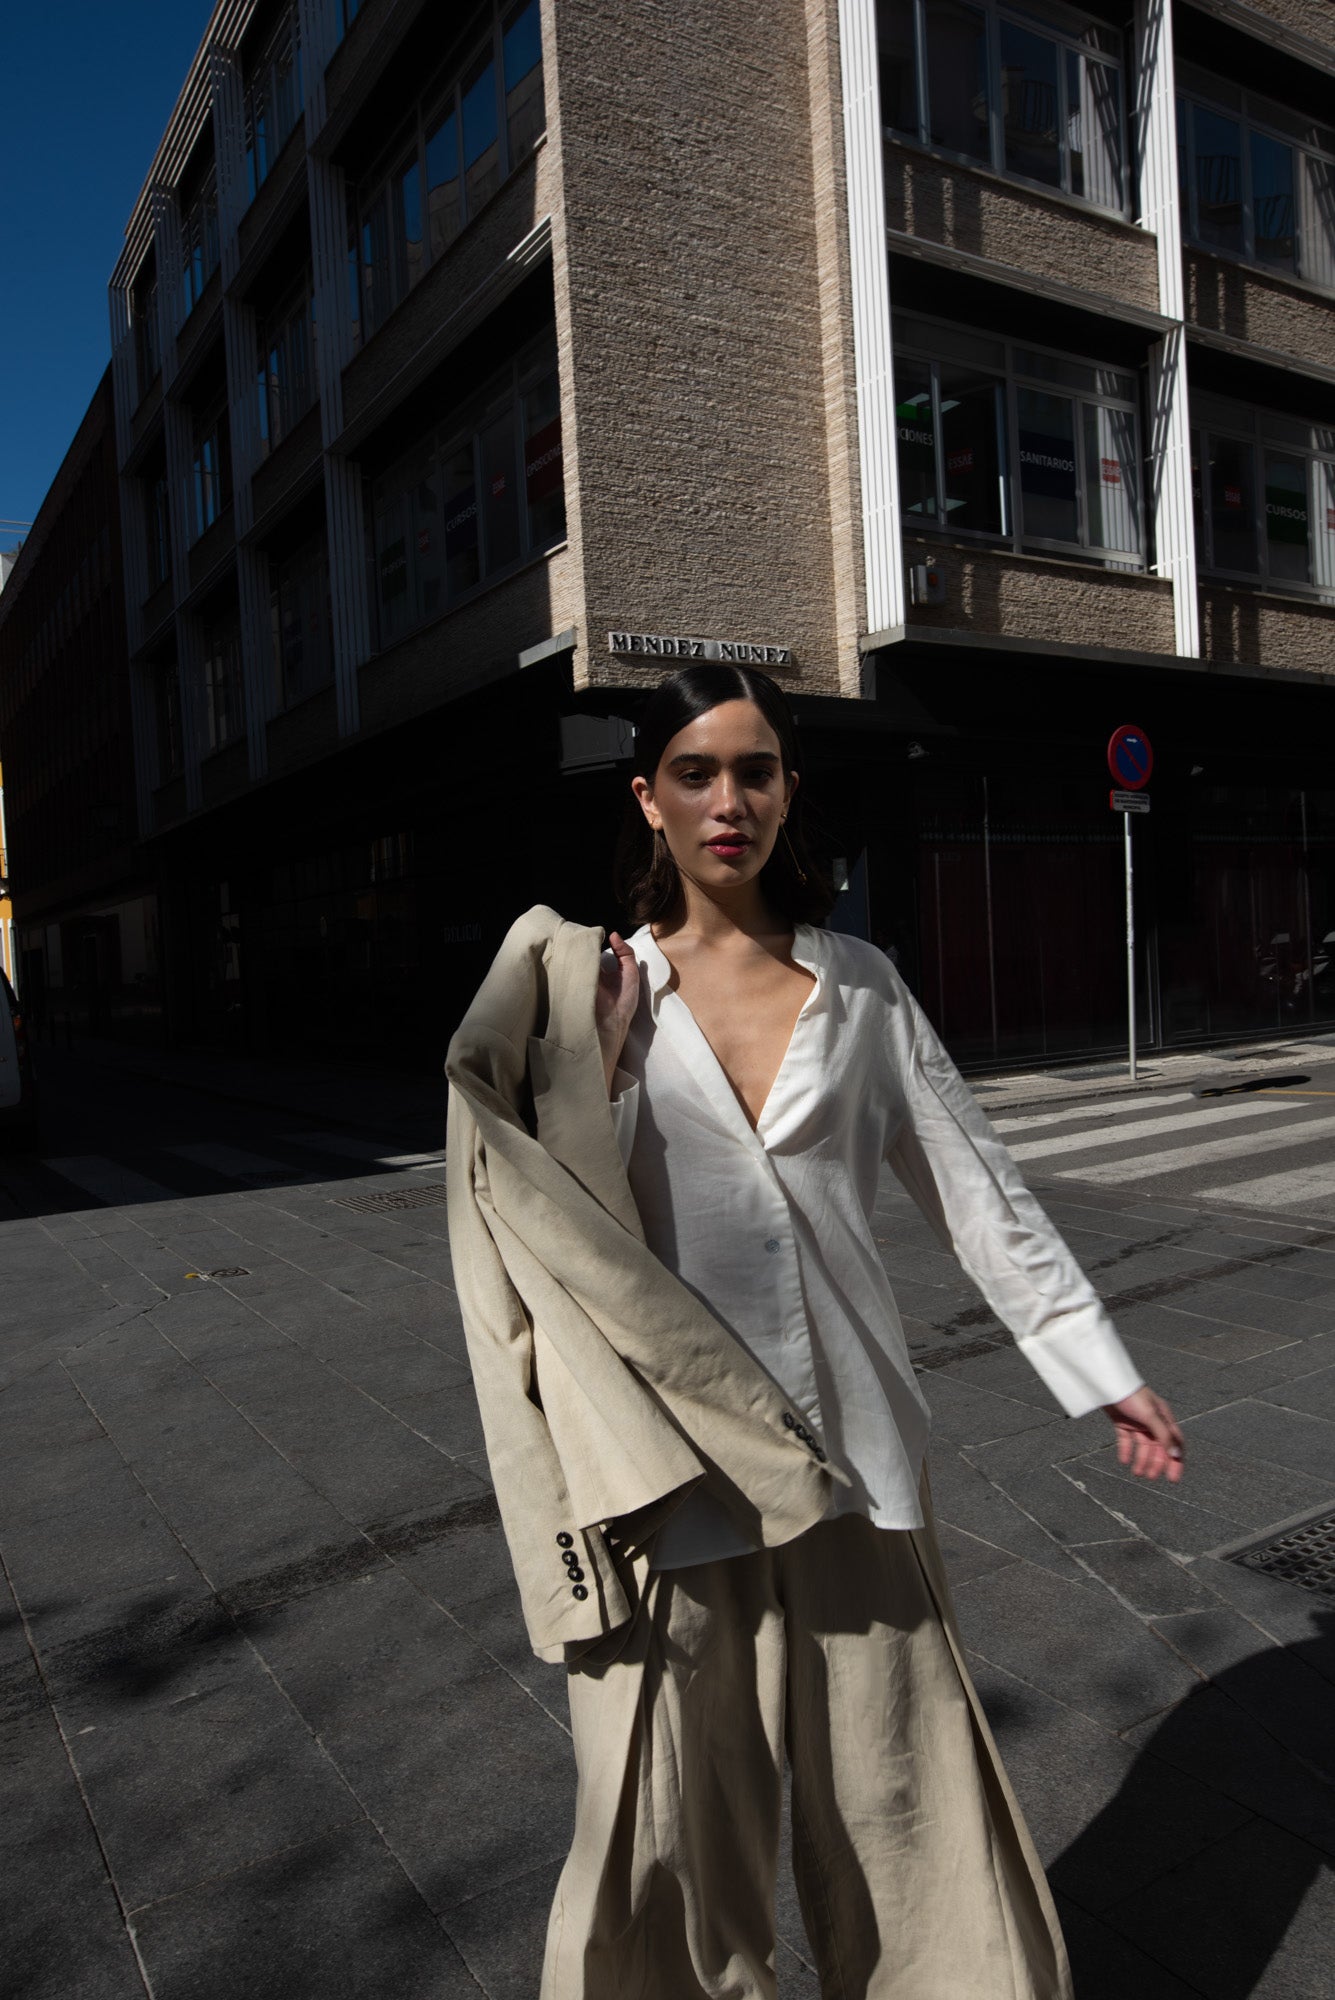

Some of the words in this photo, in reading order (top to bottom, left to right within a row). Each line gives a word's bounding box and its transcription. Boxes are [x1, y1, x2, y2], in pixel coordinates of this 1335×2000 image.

[1020, 450, 1074, 472] SANITARIOS
[1265, 503, 1307, 521] CURSOS
[612, 634, 704, 657] MENDEZ
